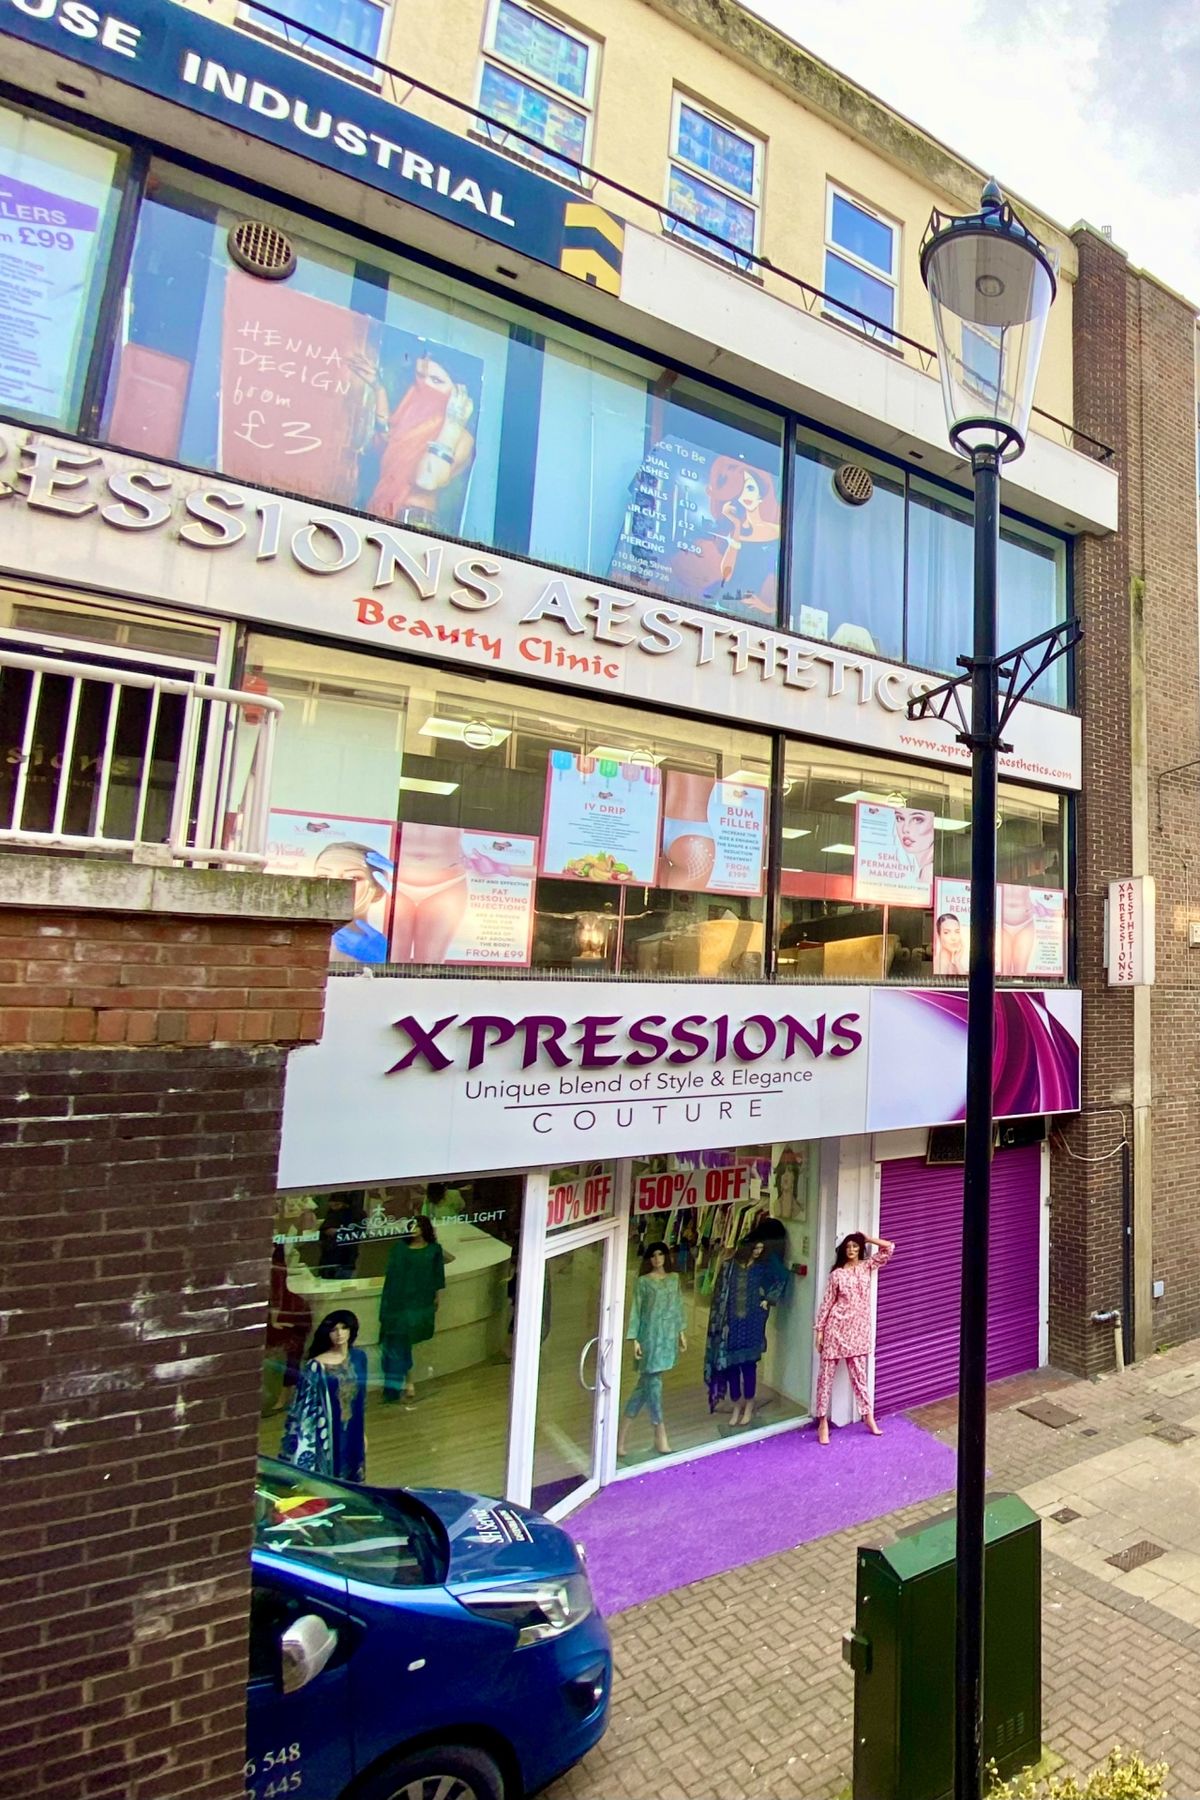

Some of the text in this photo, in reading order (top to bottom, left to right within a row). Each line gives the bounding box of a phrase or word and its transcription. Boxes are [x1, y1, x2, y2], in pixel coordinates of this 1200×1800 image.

[182, 52, 516, 228] INDUSTRIAL
[0, 203, 67, 225] LERS
[18, 226, 74, 251] £99
[237, 321, 343, 368] HENNA
[233, 347, 350, 395] DESIGN
[234, 410, 322, 455] £3
[674, 444, 689, 457] To
[691, 451, 706, 464] Be
[681, 468, 698, 479] £10
[640, 486, 668, 501] NAILS
[642, 507, 667, 522] CUTS
[678, 520, 695, 531] £12
[620, 534, 665, 554] PIERCING
[647, 531, 666, 543] EAR
[354, 597, 620, 679] Beauty Clinic
[584, 803, 626, 815] IV DRIP
[727, 806, 754, 819] BUM
[720, 817, 760, 831] FILLER
[726, 862, 750, 871] FROM
[861, 859, 915, 872] PERMANENT
[869, 870, 906, 879] MAKEUP
[470, 894, 528, 905] DISSOLVING
[492, 888, 509, 896] FAT
[470, 902, 526, 912] INJECTIONS
[1118, 883, 1126, 982] XPRESSIONS
[1126, 882, 1134, 980] AESTHETICS
[466, 948, 524, 959] FROM £99
[385, 1013, 863, 1075] XPRESSIONS
[465, 1067, 814, 1104] Unique blend of Style & Elegance
[532, 1098, 763, 1134] COUTURE
[583, 1175, 612, 1216] OFF
[639, 1167, 748, 1211] 50% OFF
[431, 1209, 506, 1228] LIMELIGHT
[336, 1231, 367, 1243] SANA
[262, 1743, 300, 1772] 548
[264, 1771, 302, 1798] 445
